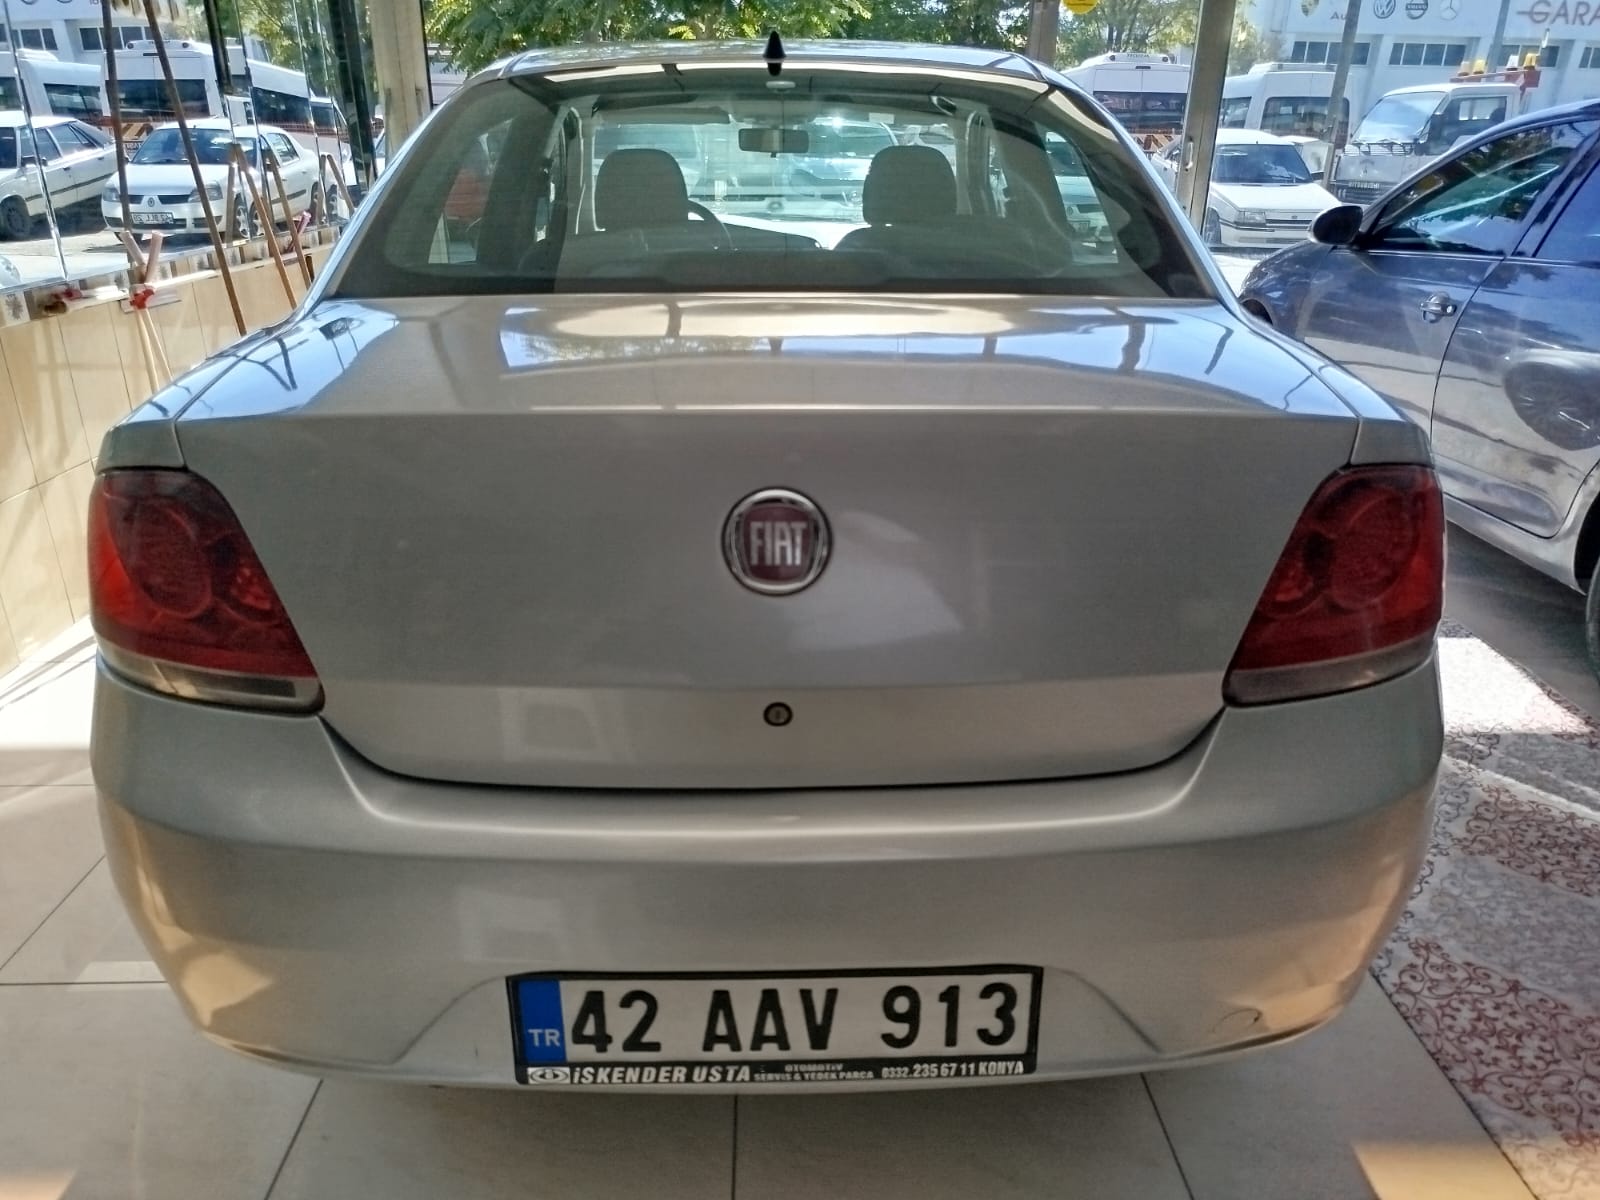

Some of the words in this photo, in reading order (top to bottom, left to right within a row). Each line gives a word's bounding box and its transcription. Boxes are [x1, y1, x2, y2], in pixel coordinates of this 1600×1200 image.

[750, 520, 807, 567] FIAT
[572, 990, 662, 1053] 42
[702, 988, 839, 1052] AAV
[881, 982, 1018, 1049] 913
[528, 1028, 561, 1047] TR
[692, 1065, 751, 1082] USTA
[804, 1071, 838, 1080] YEDEK
[978, 1061, 1025, 1076] KONYA
